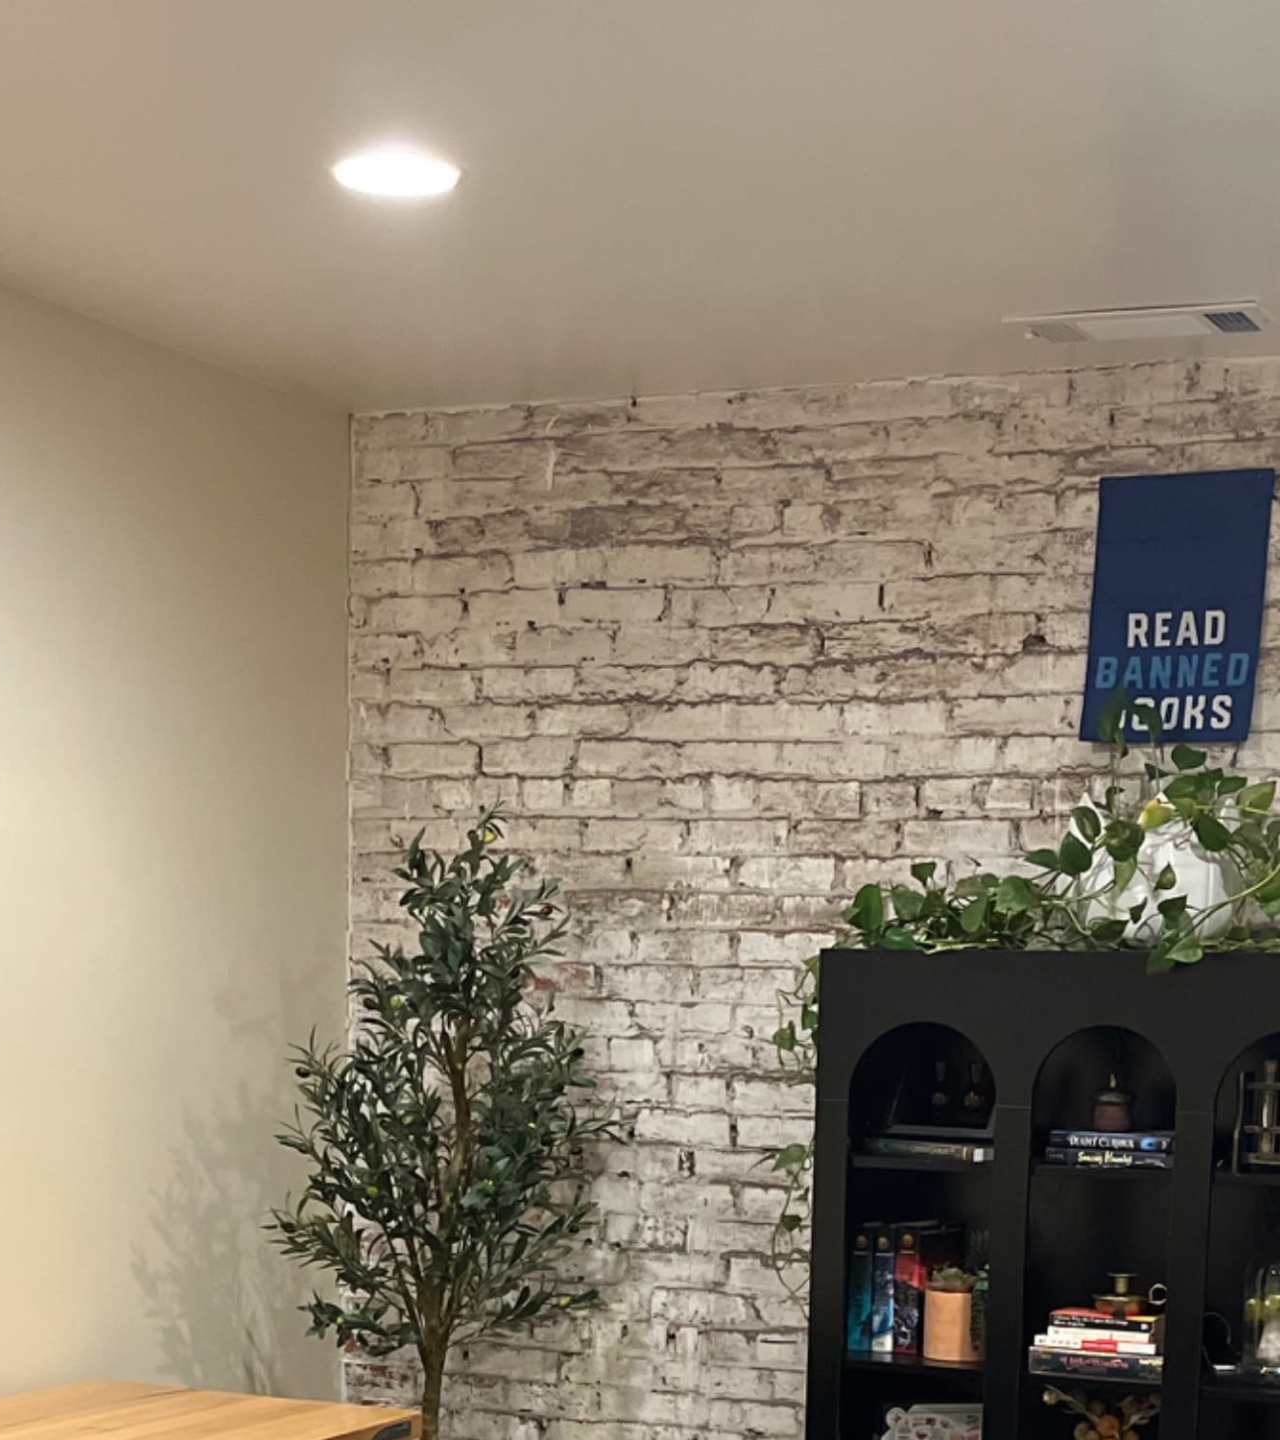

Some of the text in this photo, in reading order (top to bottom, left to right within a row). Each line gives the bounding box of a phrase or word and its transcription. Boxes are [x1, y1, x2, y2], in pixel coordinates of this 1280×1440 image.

[1127, 609, 1226, 648] READ
[1095, 652, 1250, 689] BANNED
[1118, 694, 1233, 731] OOKS
